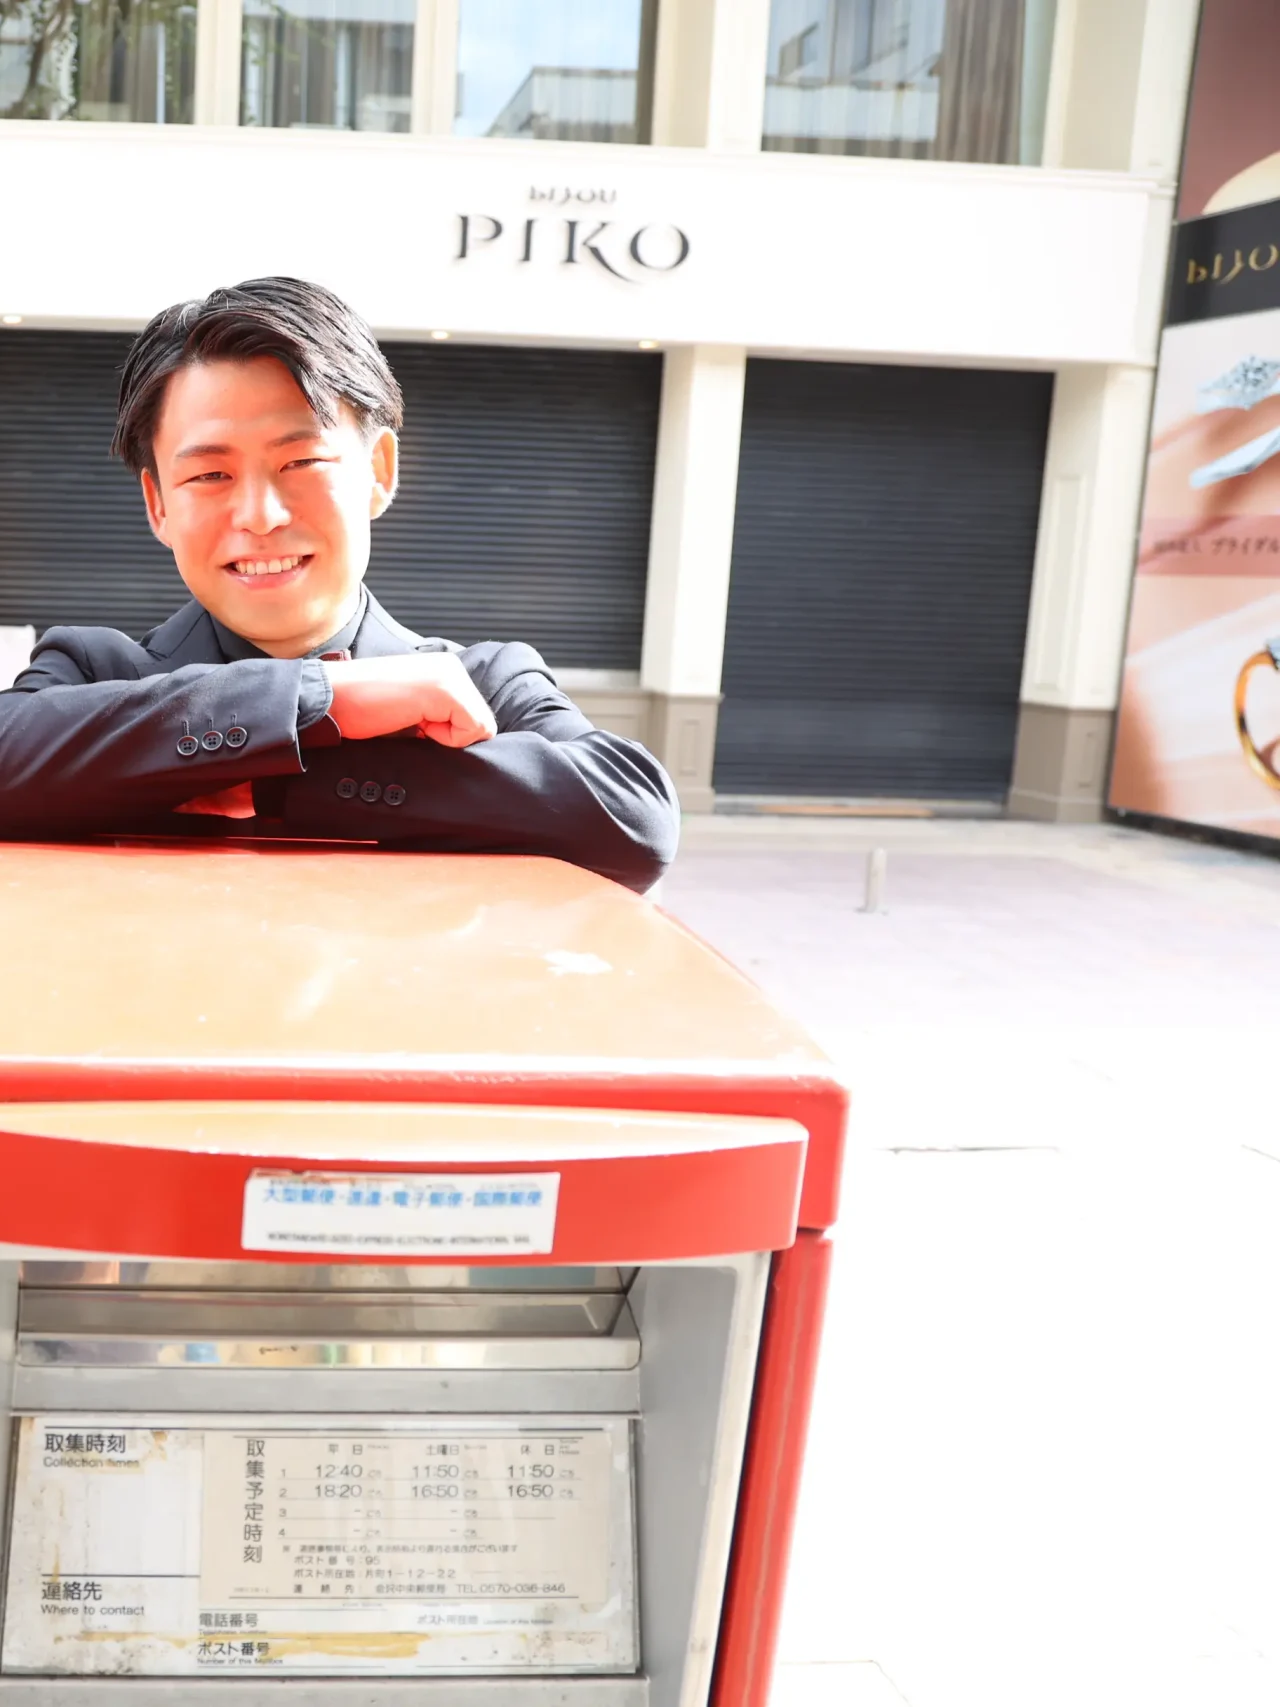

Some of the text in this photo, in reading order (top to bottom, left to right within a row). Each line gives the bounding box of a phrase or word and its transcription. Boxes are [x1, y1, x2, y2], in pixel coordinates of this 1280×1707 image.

[453, 214, 692, 284] PIKO
[45, 1433, 127, 1454] 取集時刻
[316, 1464, 363, 1478] 12:40
[412, 1464, 460, 1479] 11:50
[507, 1464, 555, 1479] 11:50
[315, 1484, 363, 1499] 18:20
[412, 1484, 460, 1499] 16:50
[507, 1484, 555, 1499] 16:50
[243, 1439, 266, 1564] 取集予定時刻
[41, 1581, 103, 1602] 連絡先
[41, 1604, 145, 1617] Where to contact
[199, 1612, 258, 1628] 電話番号
